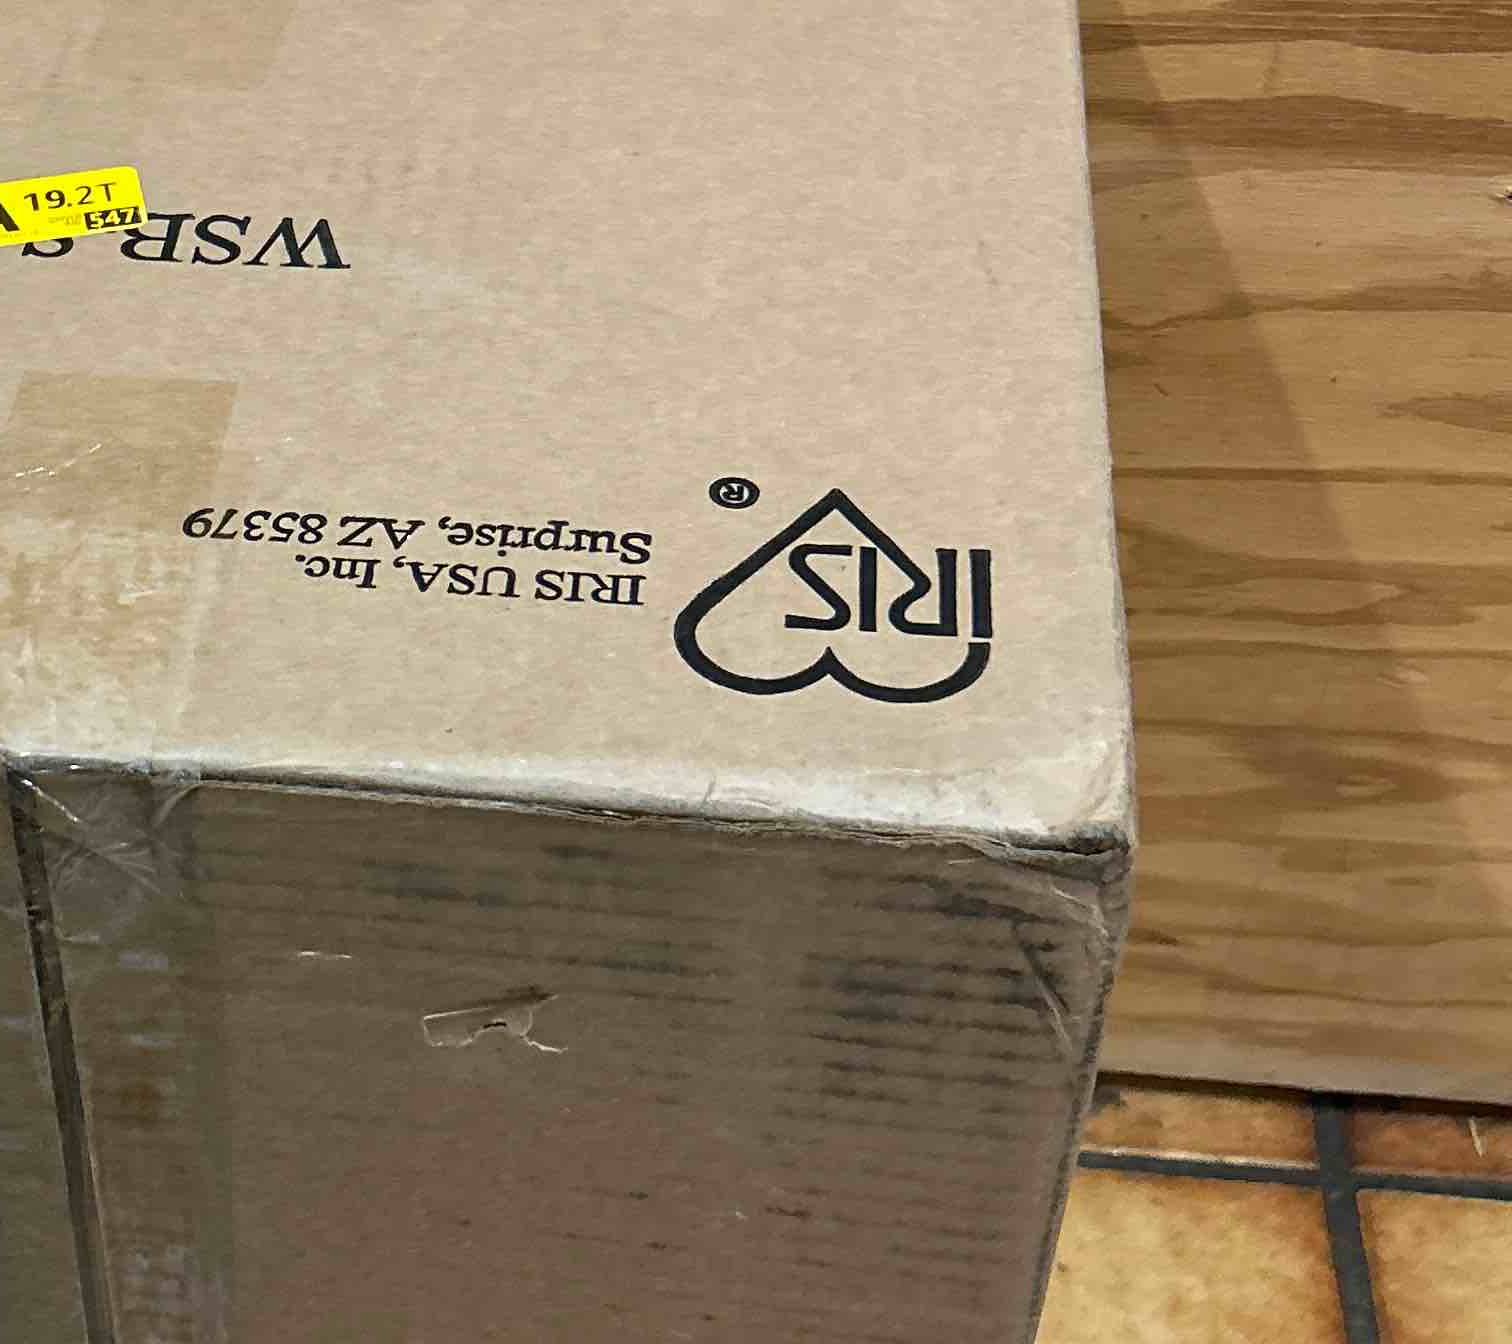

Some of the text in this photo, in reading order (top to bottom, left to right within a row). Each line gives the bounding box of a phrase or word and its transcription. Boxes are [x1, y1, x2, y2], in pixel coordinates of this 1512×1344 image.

[182, 507, 653, 565] Surprise, AZ 85379
[295, 554, 647, 606] IRIS USA, Inc.
[784, 543, 993, 638] IRIS
